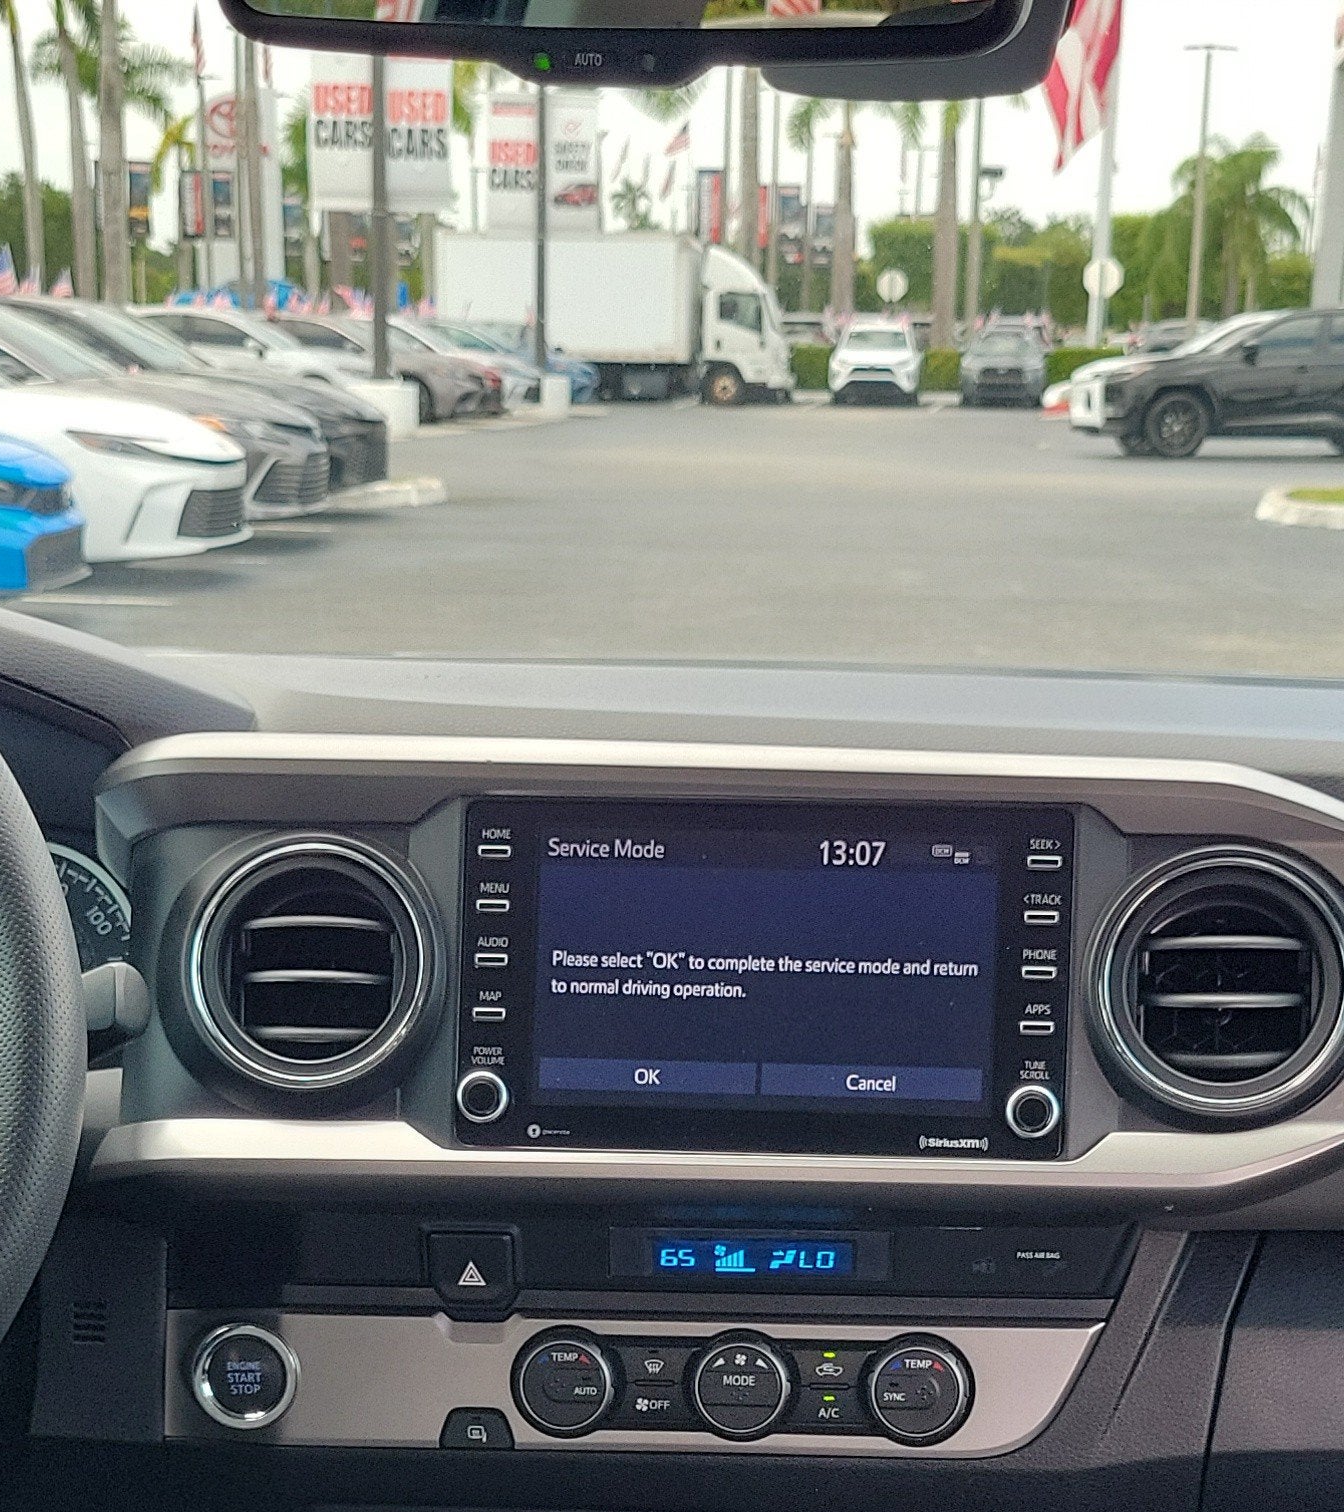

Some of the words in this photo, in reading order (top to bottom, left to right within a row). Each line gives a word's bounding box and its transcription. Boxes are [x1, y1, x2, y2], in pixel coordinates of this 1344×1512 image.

[574, 53, 603, 67] AUTO
[312, 83, 373, 117] USED
[386, 90, 449, 124] USED
[313, 119, 373, 149] CARS
[385, 128, 449, 159] CARS
[489, 139, 539, 166] USED
[490, 168, 536, 191] CARS
[481, 828, 512, 840] HOME
[547, 837, 610, 858] Service
[613, 838, 666, 859] Mode
[818, 839, 887, 867] 13:07
[479, 881, 510, 894] MENU
[86, 905, 113, 936] 100
[477, 936, 509, 948] AUDIO
[1022, 948, 1057, 961] PHONE
[551, 949, 599, 969] Please
[601, 951, 643, 969] select
[646, 950, 686, 970] "OK"
[688, 954, 705, 971] to
[707, 953, 775, 975] complete
[778, 954, 802, 972] the
[805, 956, 856, 974] service
[858, 957, 900, 975] mode
[903, 958, 931, 976] and
[933, 960, 979, 977] return
[479, 990, 502, 1002] MAP
[551, 978, 567, 993] to
[569, 978, 620, 995] normal
[622, 979, 671, 1000] driving
[673, 981, 747, 1001] operation.
[1024, 1003, 1052, 1016] APPS
[473, 1045, 504, 1057] POWER
[470, 1055, 506, 1067] VOLUME
[1024, 1060, 1047, 1072] TUNE
[633, 1068, 662, 1086] OK
[1019, 1070, 1051, 1081] SCROLL
[845, 1073, 897, 1093] Cancel
[659, 1248, 697, 1268] 65
[1016, 1251, 1034, 1260] PASS
[1045, 1251, 1060, 1260] BAG
[551, 1352, 579, 1362] TEMP
[904, 1358, 933, 1369] TEMP
[226, 1361, 262, 1371] ENGINE
[227, 1372, 262, 1383] START
[722, 1374, 756, 1387] MODE
[230, 1384, 261, 1395] STOP
[573, 1386, 598, 1396] AUTO
[882, 1392, 906, 1402] SYNC
[649, 1400, 671, 1411] OFF
[817, 1408, 840, 1419] A/C
